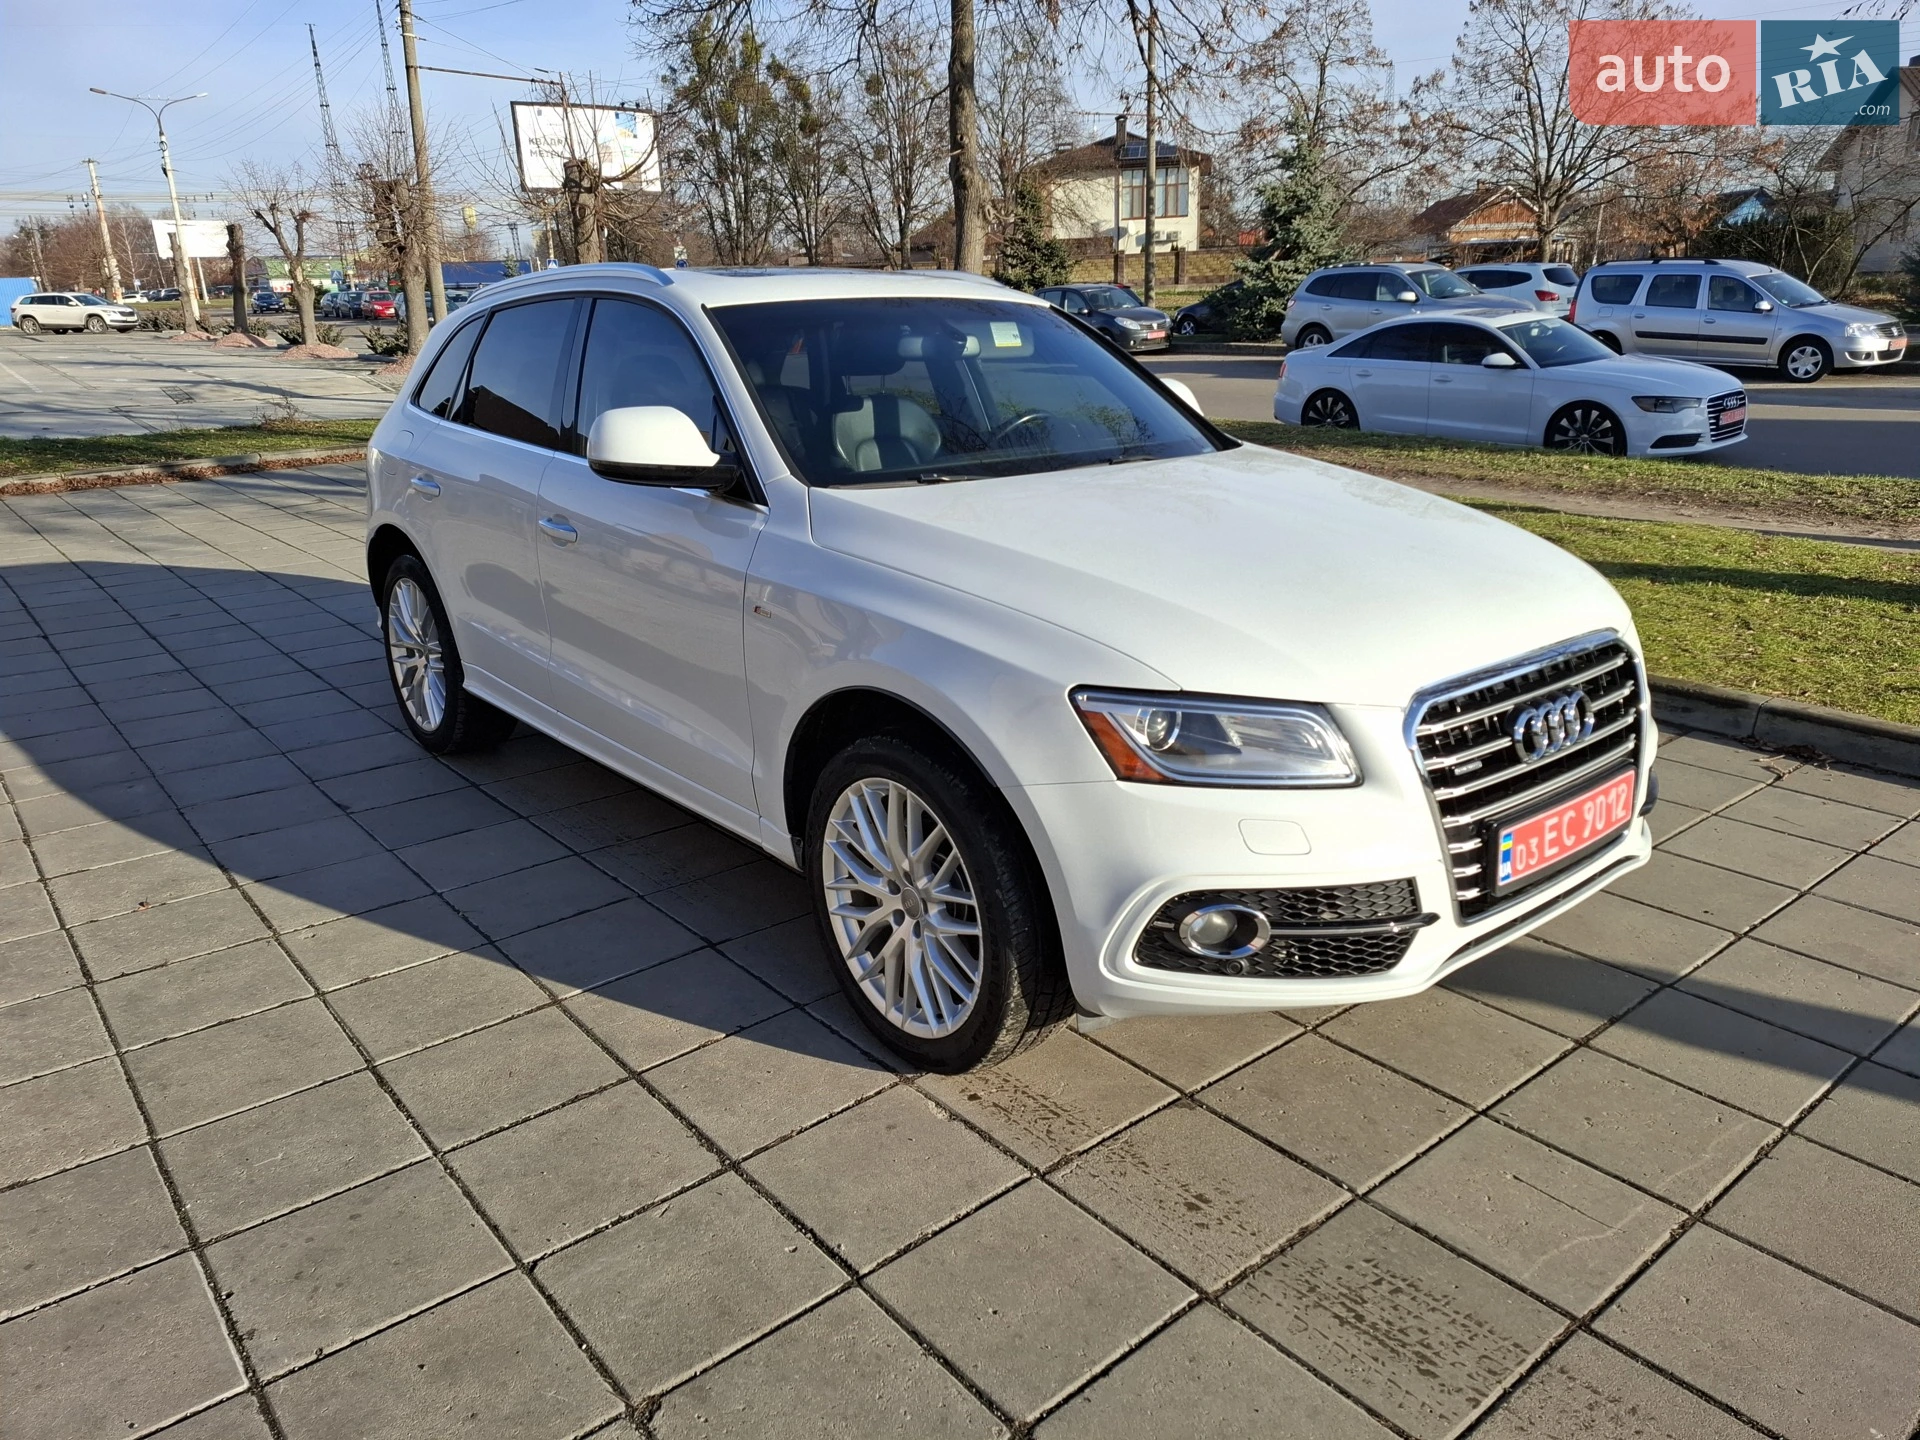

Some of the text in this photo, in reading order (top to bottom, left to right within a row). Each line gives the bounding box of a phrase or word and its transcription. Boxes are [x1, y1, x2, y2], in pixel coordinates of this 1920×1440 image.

[1516, 783, 1628, 870] 03 EC 9012
